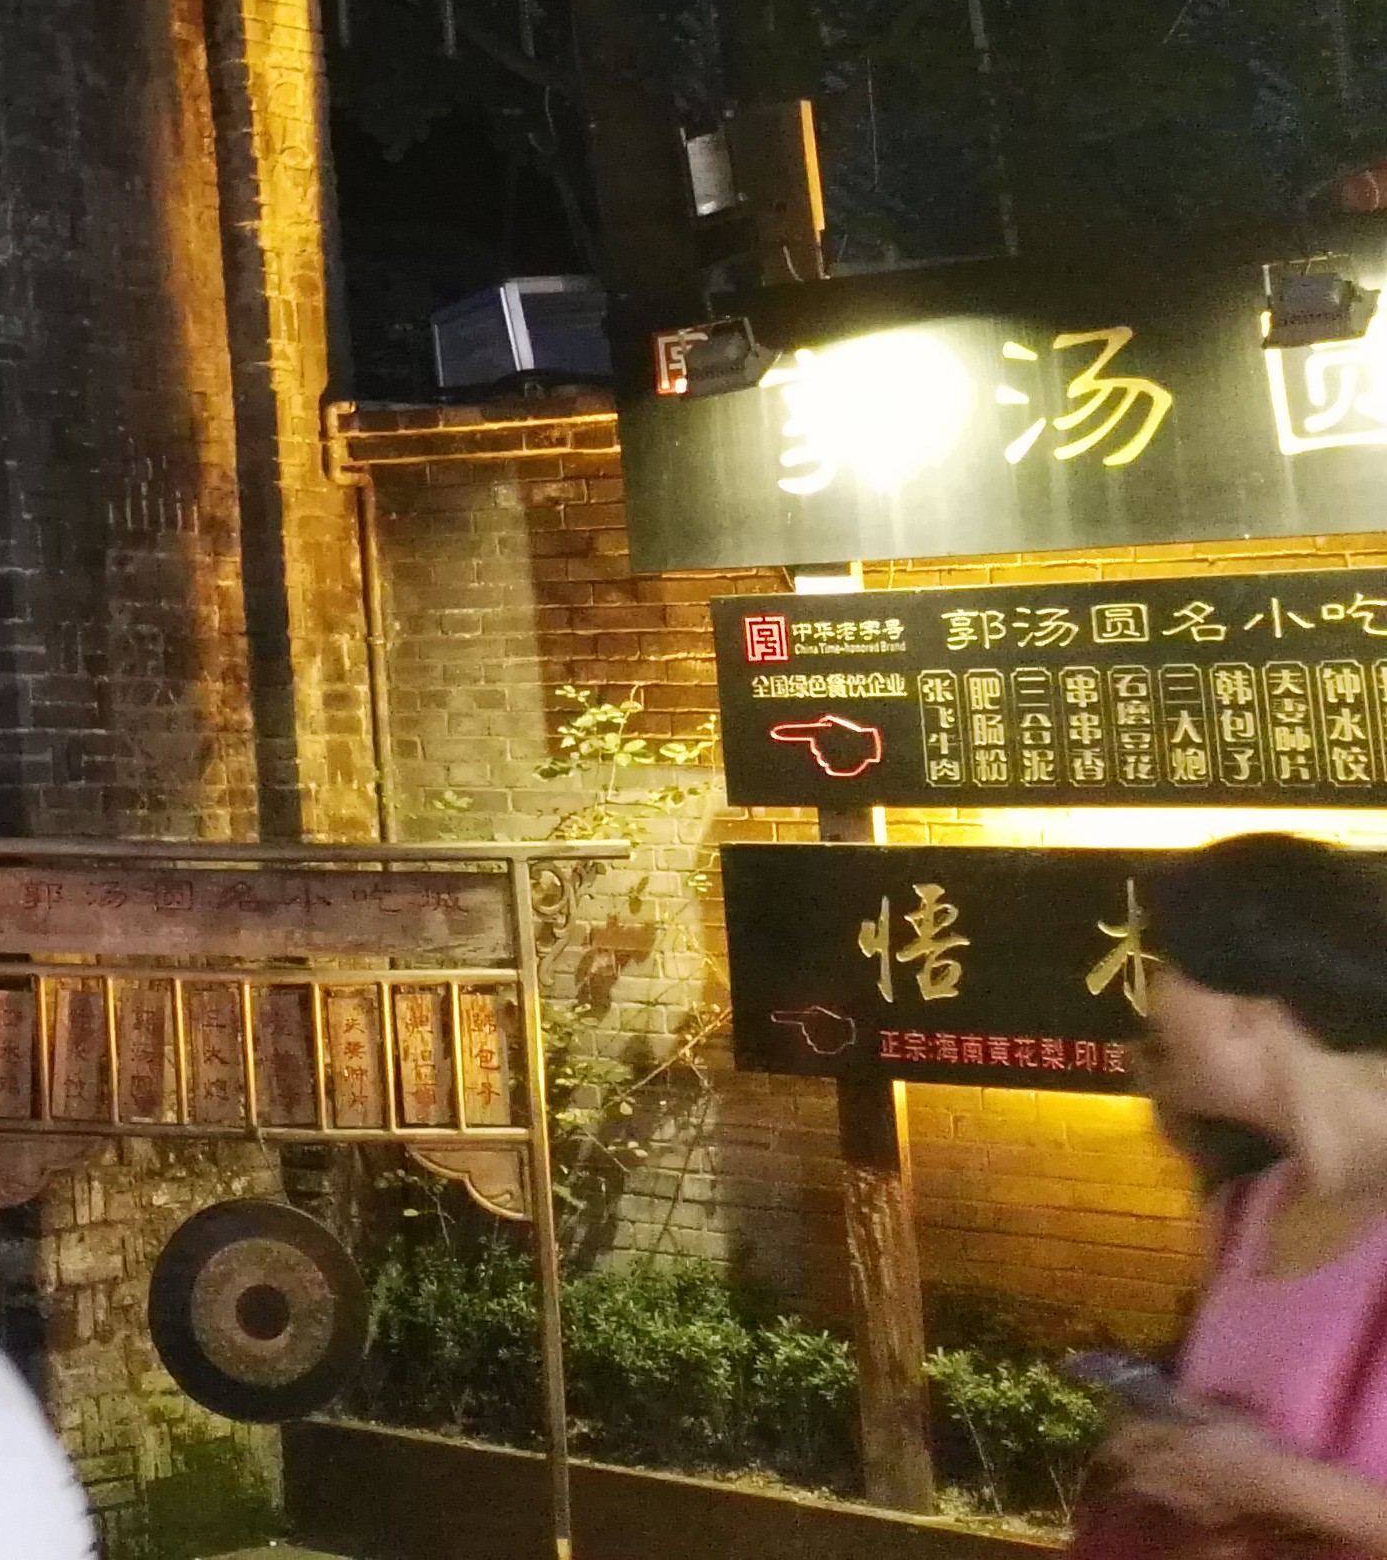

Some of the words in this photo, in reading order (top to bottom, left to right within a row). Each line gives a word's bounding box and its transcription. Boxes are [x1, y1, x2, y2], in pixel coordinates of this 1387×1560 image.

[792, 618, 905, 642] 中华老字号
[751, 671, 909, 699] 全国绿色餐饮企业
[922, 677, 962, 781] 张飞牛肉
[968, 676, 1008, 782] 肥肠粉
[1017, 676, 1056, 781] 三合泥
[1065, 674, 1105, 781] 串串香
[1113, 673, 1156, 780] 石磨豆花
[1165, 673, 1207, 781] 三大炮
[1215, 670, 1257, 781] 韩包子
[1269, 669, 1312, 781] 夫妻肺片
[1322, 667, 1371, 782] 钟水饺
